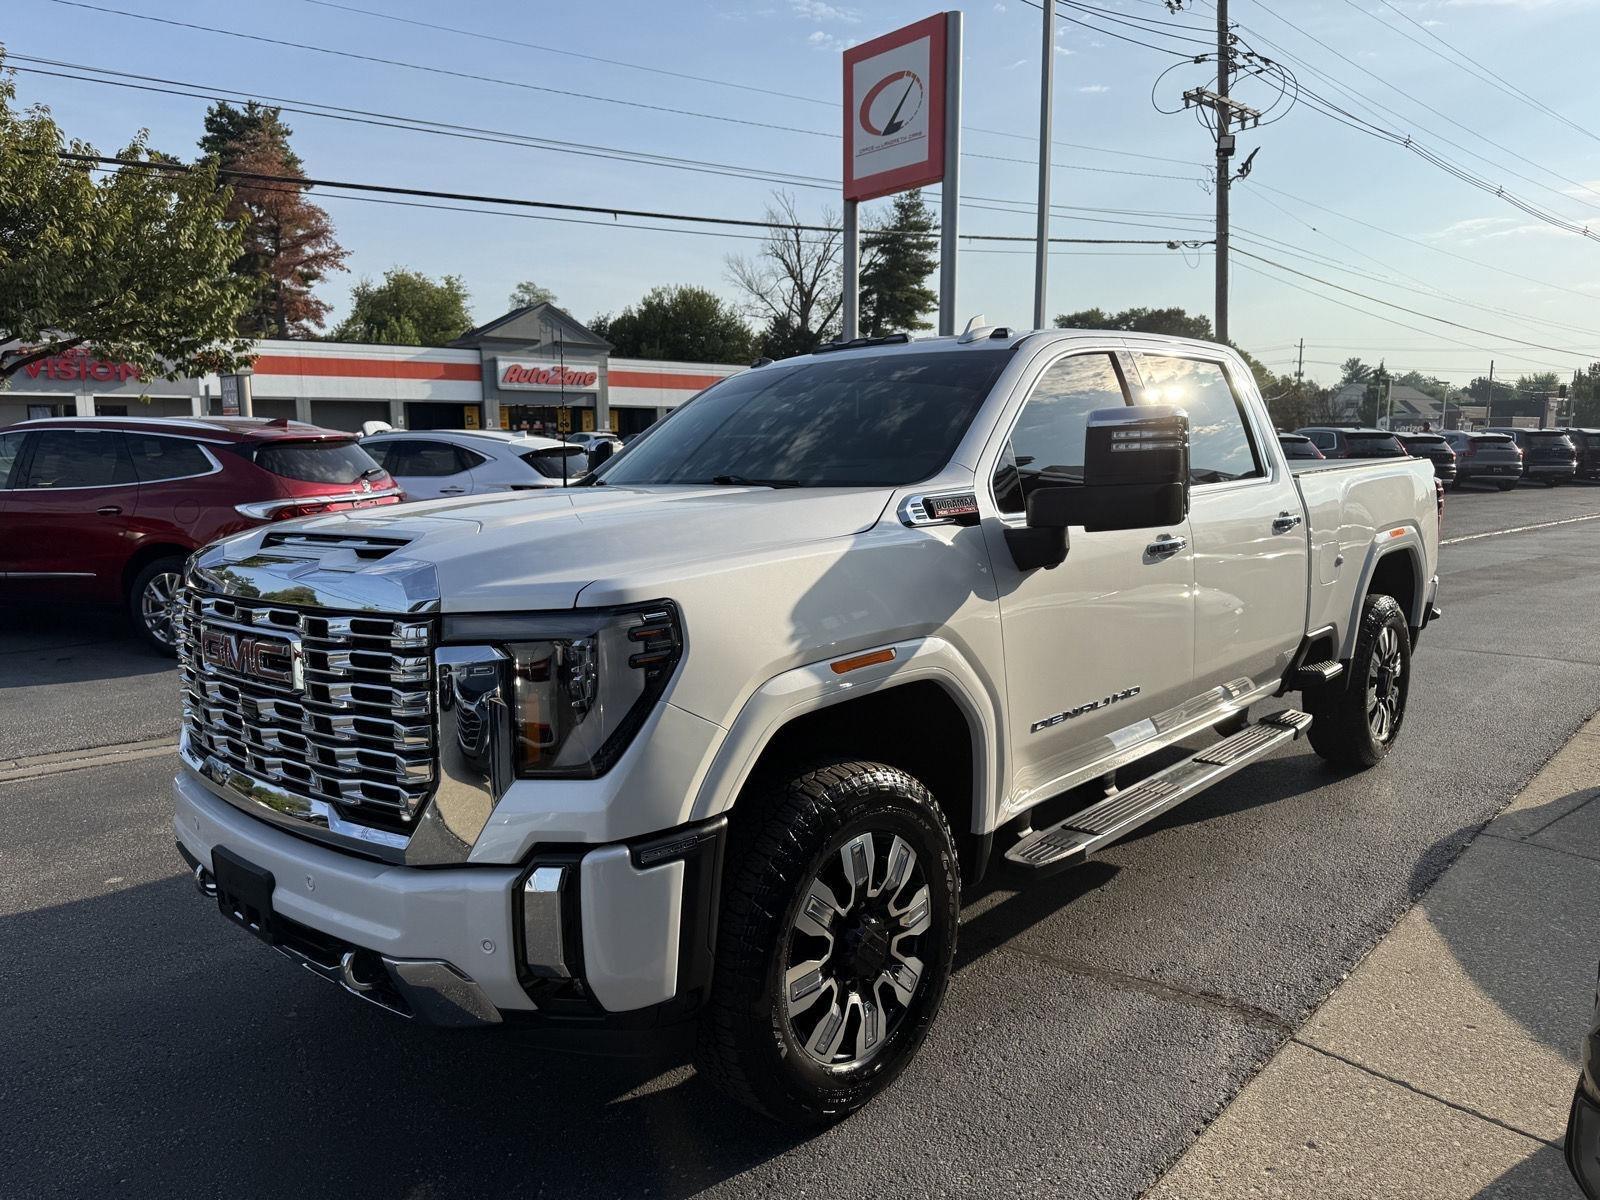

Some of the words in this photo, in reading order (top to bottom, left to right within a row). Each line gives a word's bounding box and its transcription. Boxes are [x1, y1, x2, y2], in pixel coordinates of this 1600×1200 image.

[502, 363, 597, 386] AutoZone
[1394, 423, 1426, 432] verizo
[936, 497, 975, 510] DURAMAX
[201, 630, 291, 682] GMC
